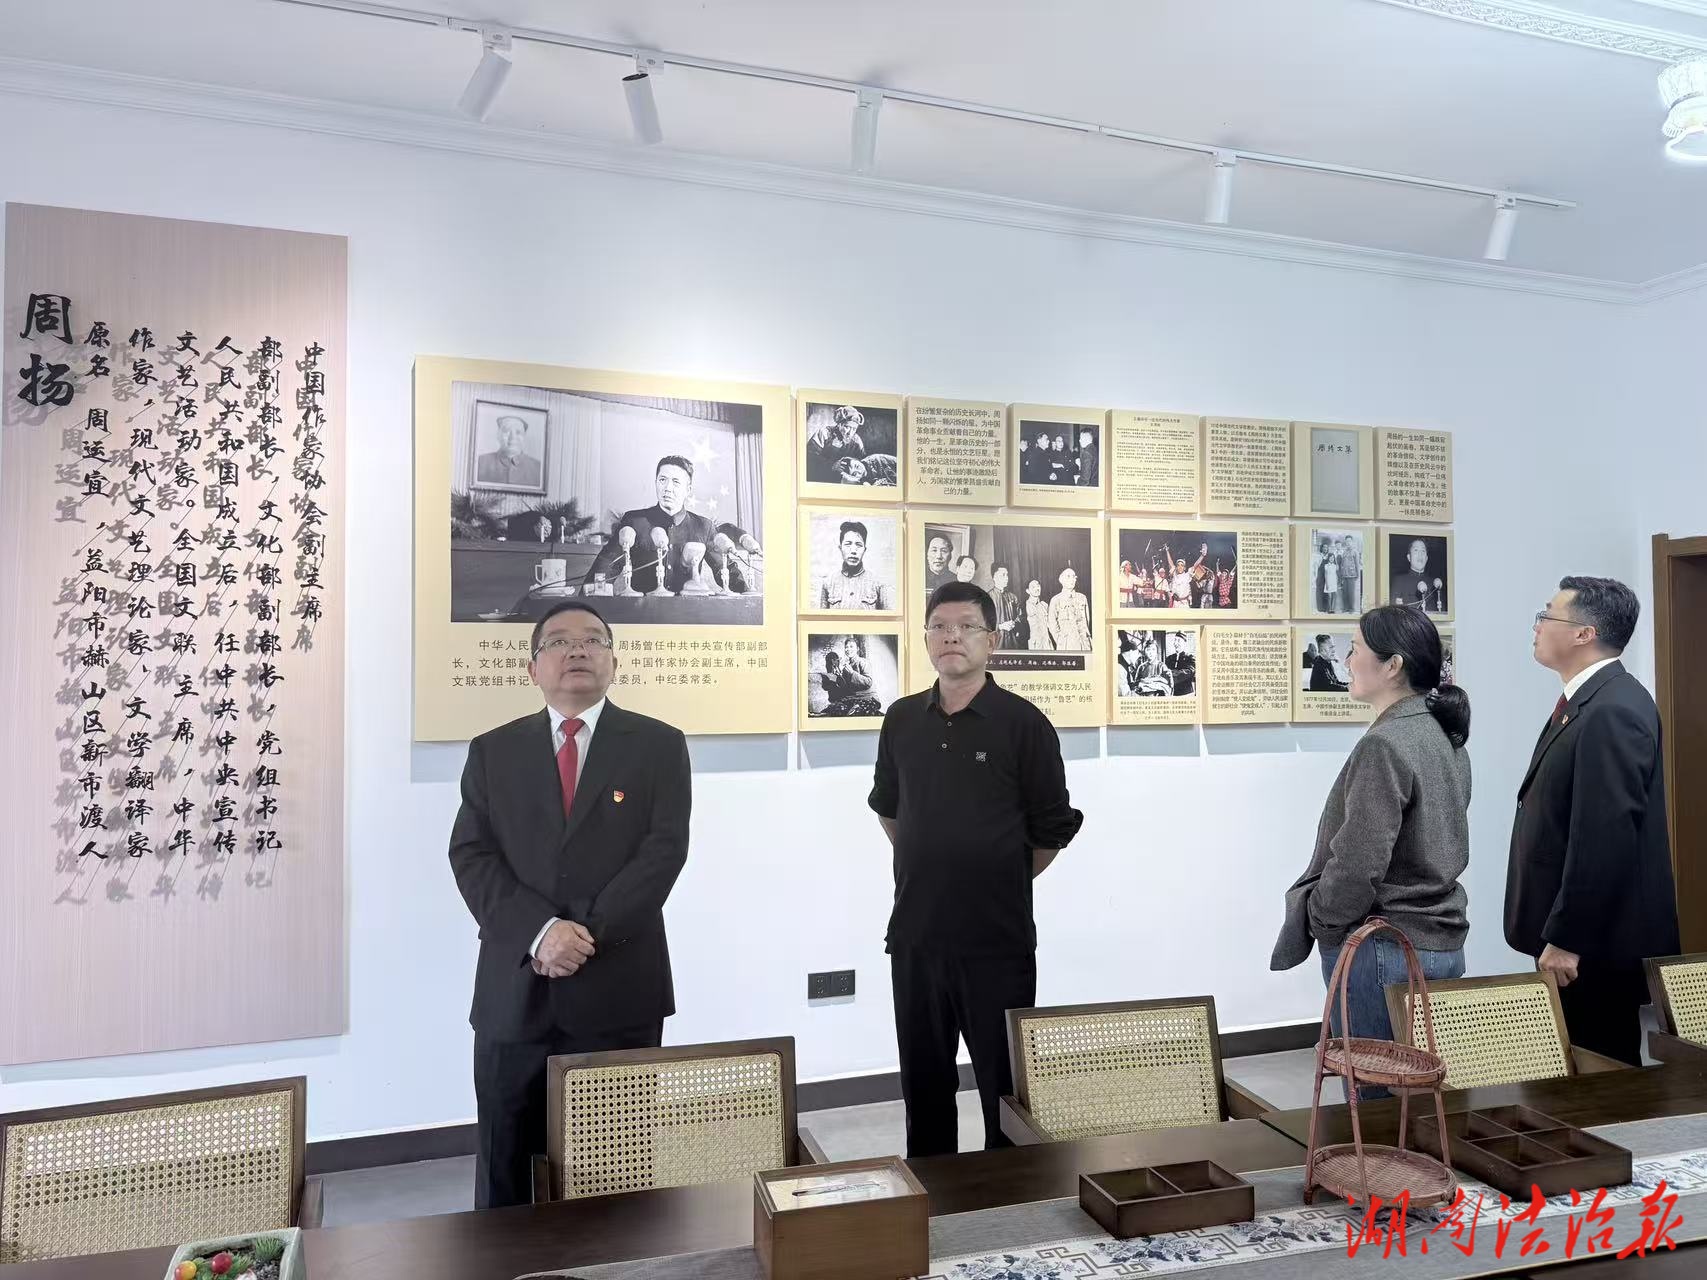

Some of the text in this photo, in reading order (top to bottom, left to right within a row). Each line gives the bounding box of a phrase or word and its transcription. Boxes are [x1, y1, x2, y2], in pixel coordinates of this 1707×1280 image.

[18, 293, 75, 406] 周扬
[299, 342, 328, 622] 中国作家协会副主席
[479, 640, 768, 652] 中华人民 周扬曾任中共中央宣传部副部
[452, 675, 530, 687] 文联党组书记
